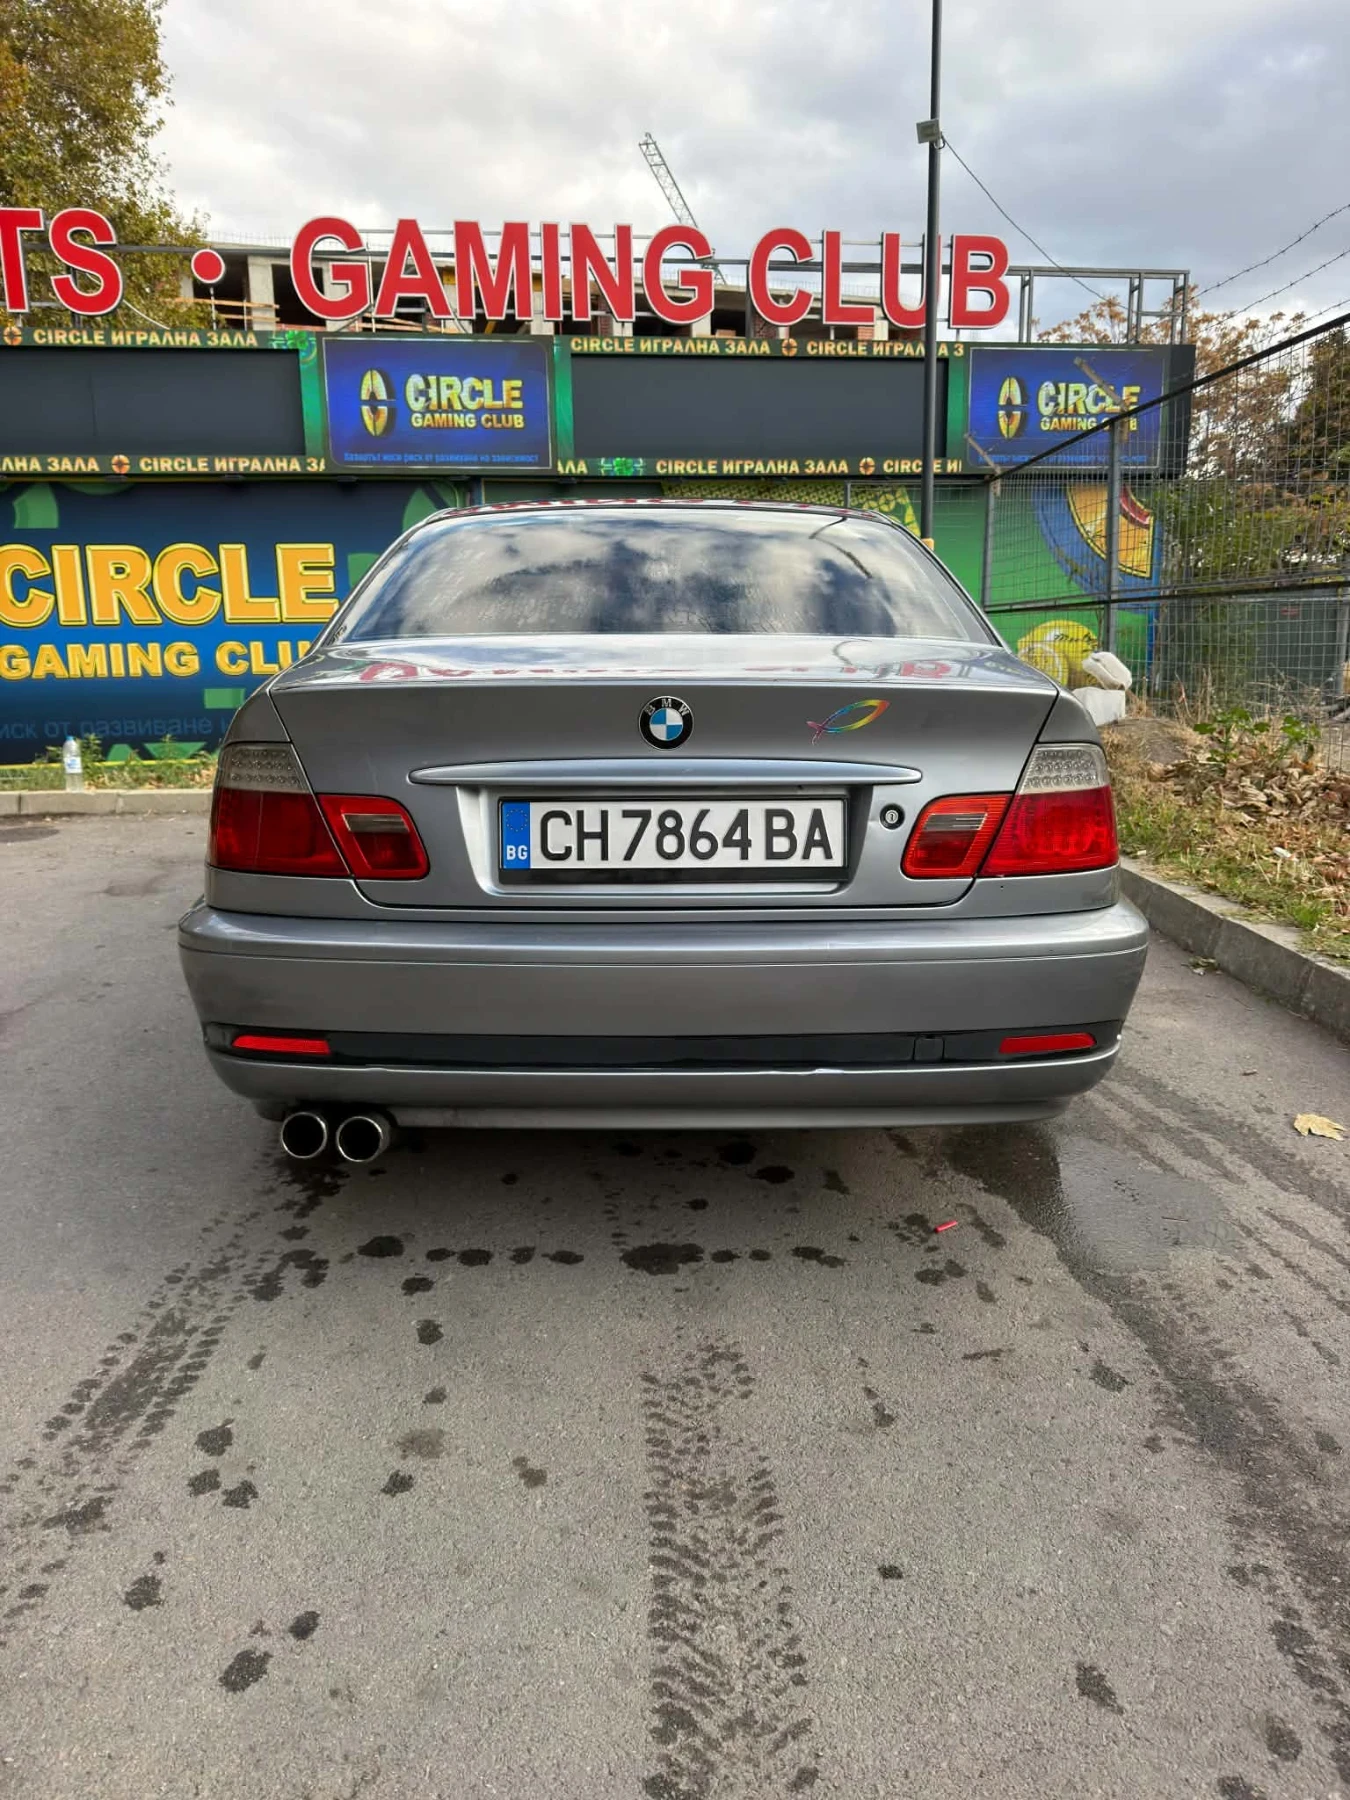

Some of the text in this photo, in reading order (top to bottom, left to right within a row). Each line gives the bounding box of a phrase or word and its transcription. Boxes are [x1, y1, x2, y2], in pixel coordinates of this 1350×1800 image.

[291, 216, 715, 325] GAMING
[749, 227, 1010, 330] CLUB
[33, 328, 258, 348] CIRCLE ИГРАЛНА ЗАЛА
[570, 337, 771, 355] CIRCLE ИГРАЛНА ЗАЛА
[806, 341, 867, 357] CIRCLE
[872, 342, 949, 357] ИГРАЛА
[405, 374, 524, 412] CIRCLE
[1038, 381, 1141, 416] CIRCLE
[411, 413, 524, 429] GAMING CLUB
[1040, 417, 1097, 431] GAMING
[0, 456, 100, 472] ЛНА ЗАЛА
[139, 457, 208, 472] CIRCLE
[214, 457, 301, 472] ИГРАЛНА
[656, 459, 849, 474] CIRCLE ИГРАЛНА ЗАЛА
[883, 459, 942, 473] CIRCE
[0, 543, 339, 627] CIRCLE
[0, 641, 312, 680] GAMING CLU
[644, 698, 690, 716] BMW
[44, 720, 71, 738] от
[505, 844, 529, 862] BG
